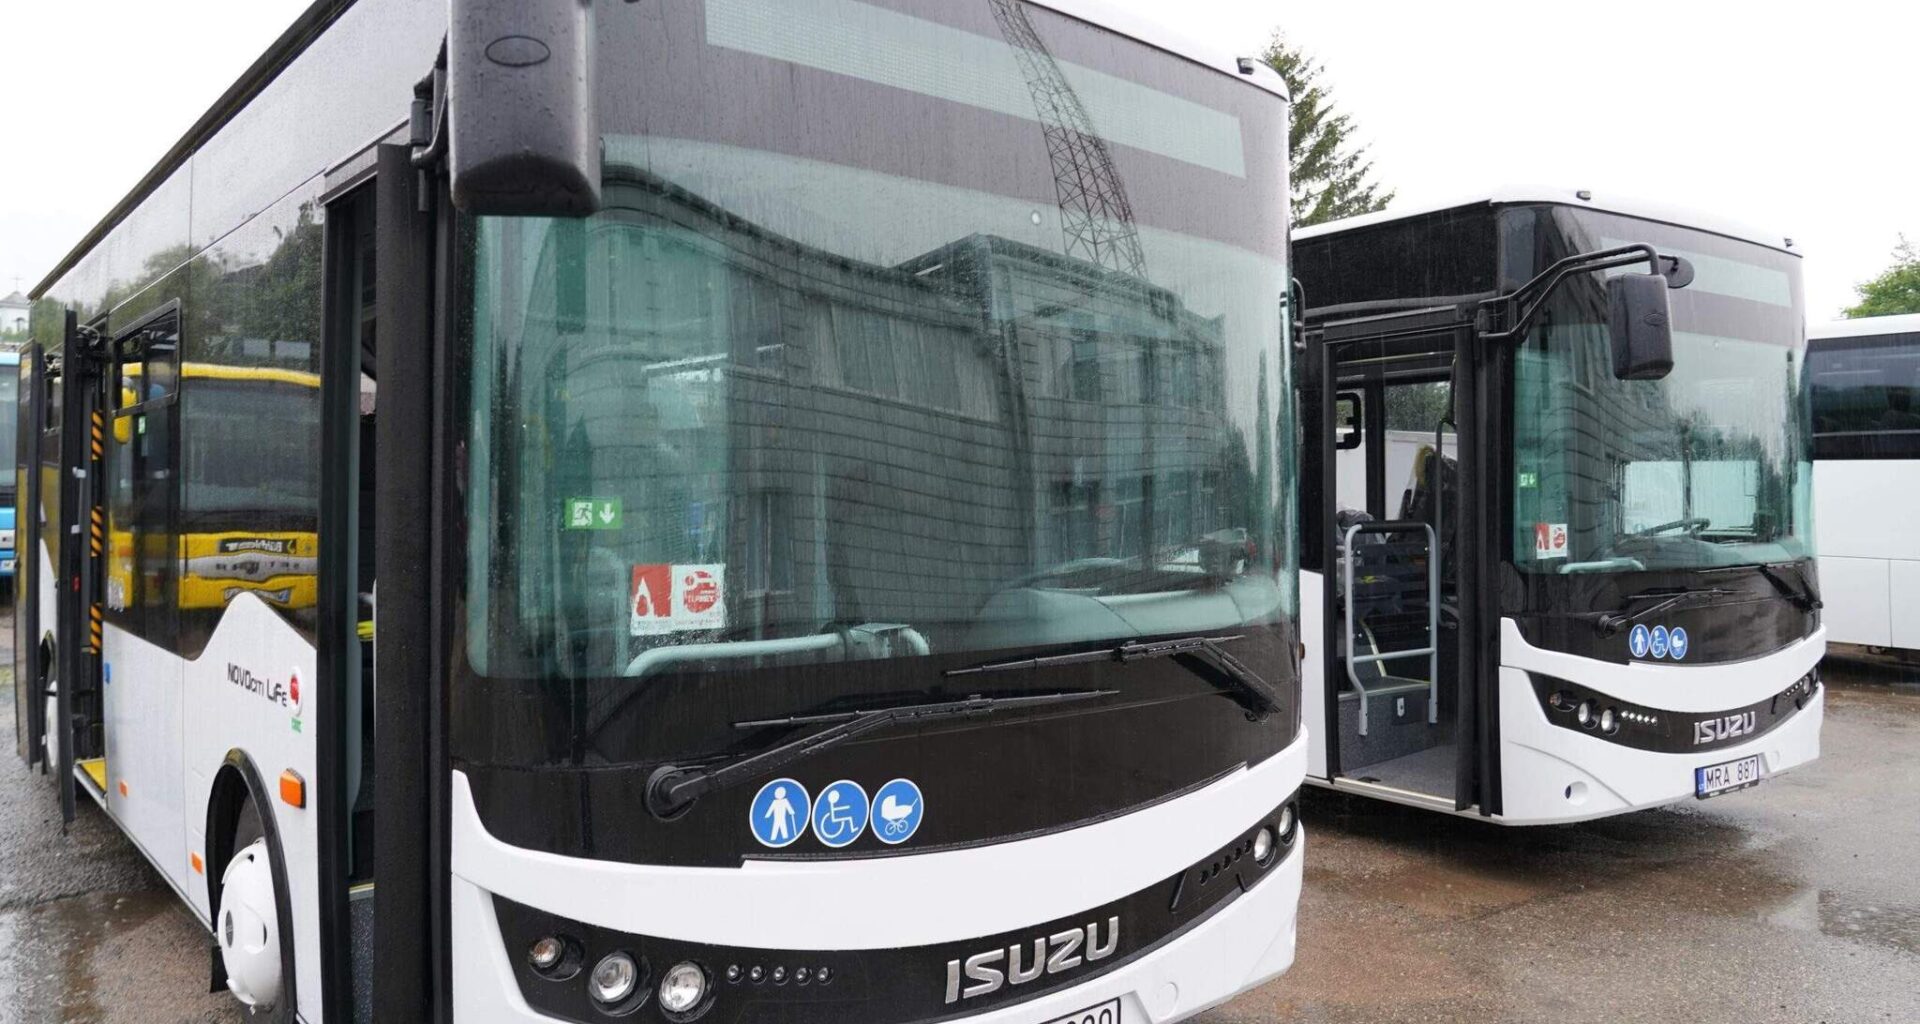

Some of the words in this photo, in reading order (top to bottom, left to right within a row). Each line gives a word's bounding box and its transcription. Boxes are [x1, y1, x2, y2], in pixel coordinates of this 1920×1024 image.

[1694, 711, 1756, 744] ISUZU
[1707, 767, 1730, 788] MRA
[1738, 760, 1756, 781] 887
[944, 915, 1119, 1005] ISUZU
